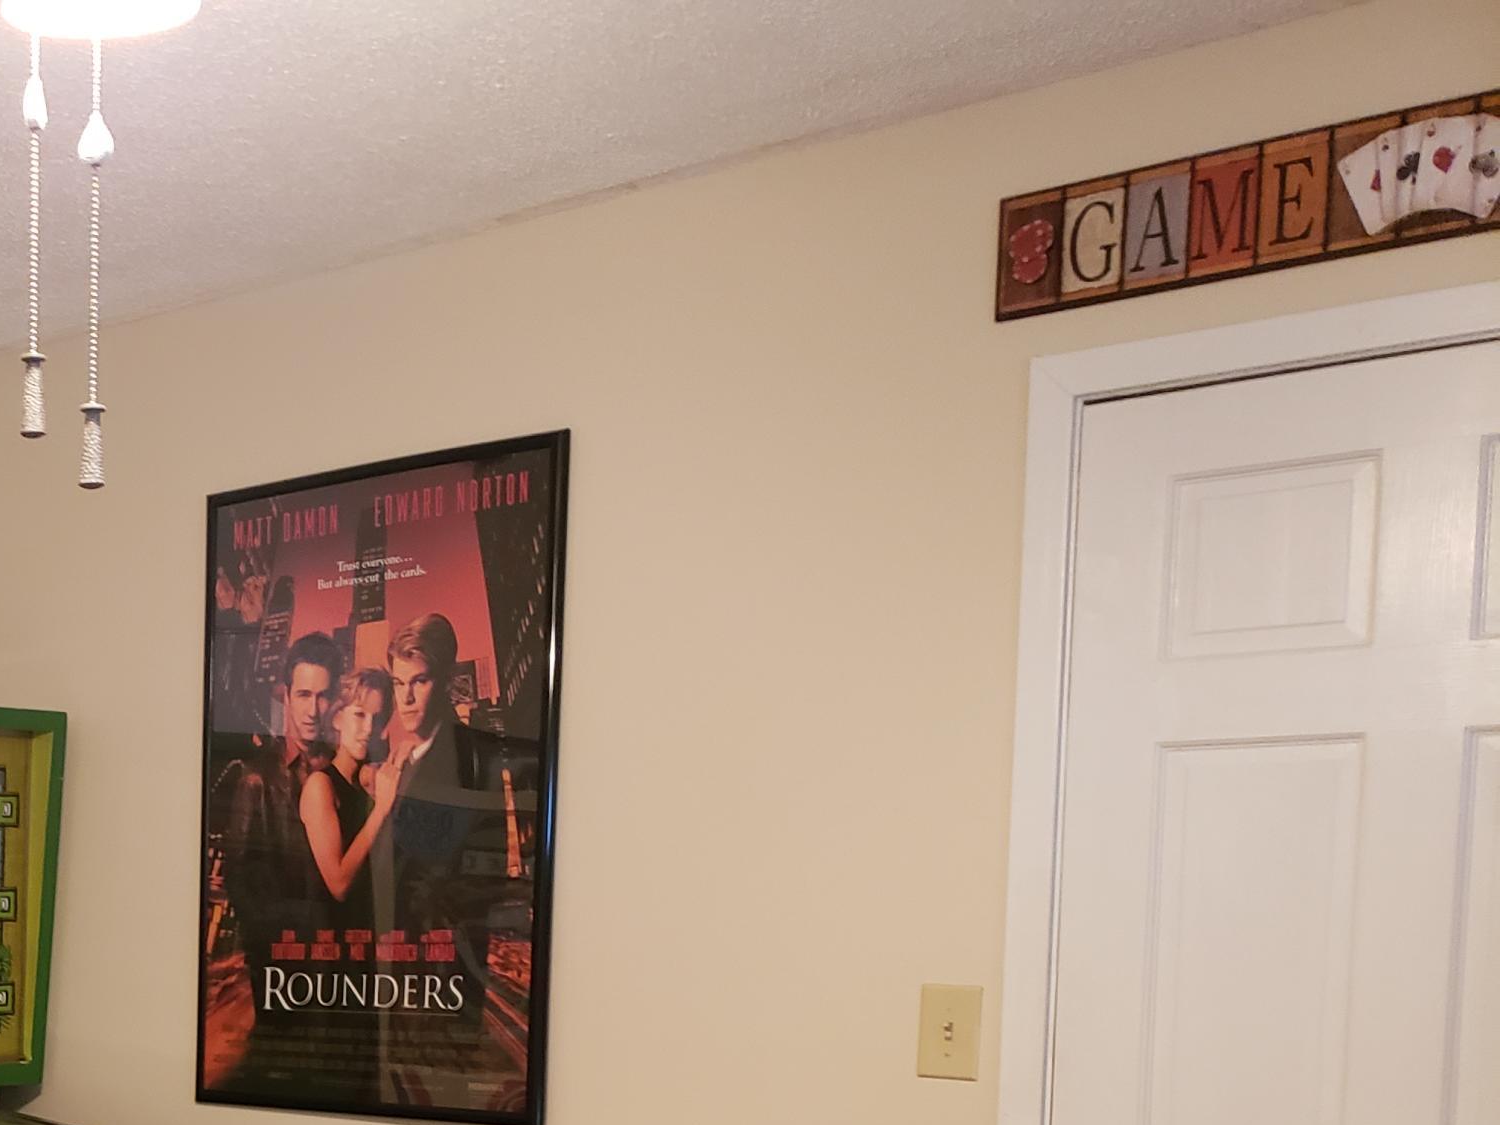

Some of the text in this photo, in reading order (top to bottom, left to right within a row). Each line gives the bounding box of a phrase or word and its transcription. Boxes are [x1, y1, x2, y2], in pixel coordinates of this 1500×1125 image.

[1070, 155, 1315, 283] GAME
[234, 470, 529, 549] MATT DAMON EDWARD NORTON
[318, 578, 333, 590] But
[263, 966, 464, 1012] ROUNDERS
